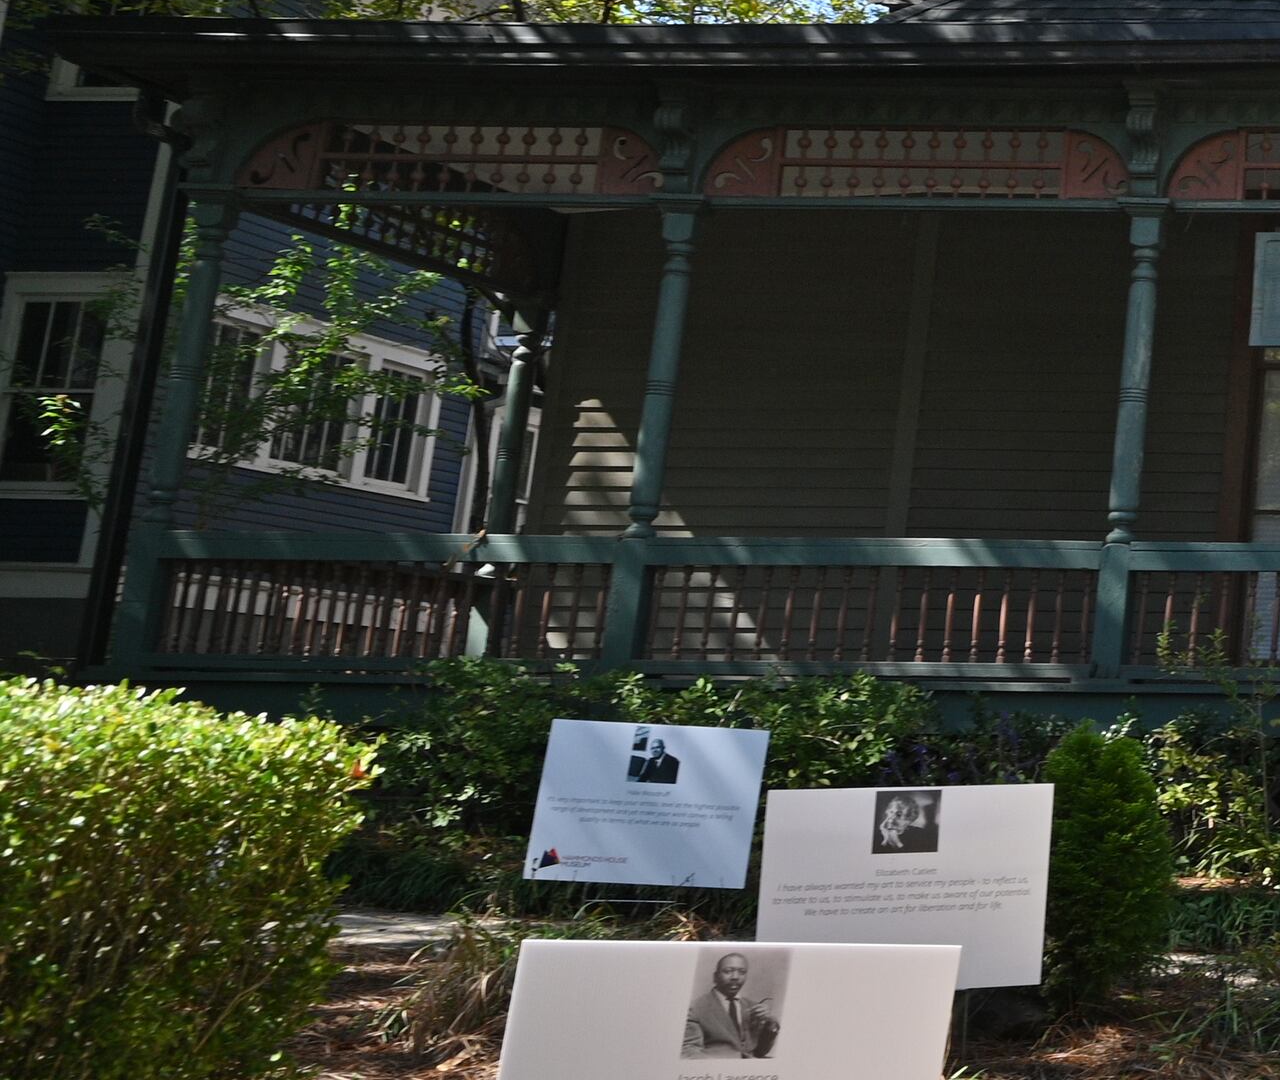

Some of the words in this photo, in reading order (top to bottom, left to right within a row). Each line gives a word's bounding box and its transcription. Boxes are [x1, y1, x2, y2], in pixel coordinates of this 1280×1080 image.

[875, 868, 910, 877] Elizabeth
[912, 867, 938, 876] Catlett
[783, 883, 802, 892] have
[804, 883, 832, 893] always
[834, 881, 866, 890] wanted
[867, 882, 880, 891] my
[881, 881, 893, 889] art
[905, 880, 932, 888] service
[933, 880, 947, 889] my
[949, 878, 976, 888] people
[982, 877, 992, 885] to
[993, 876, 1017, 886] reflect
[772, 897, 782, 905] to
[783, 896, 807, 905] relate
[808, 896, 818, 904] to
[832, 895, 842, 903] to
[843, 894, 882, 903] stimulate
[896, 893, 906, 901] to
[907, 892, 929, 900] make
[943, 891, 968, 899] aware
[969, 889, 979, 901] of
[979, 890, 993, 898] our
[804, 907, 818, 916] We
[819, 907, 839, 916] have
[840, 907, 850, 915] to
[851, 906, 876, 915] create
[878, 906, 890, 914] an
[891, 904, 904, 913] art
[903, 904, 918, 915] for
[920, 903, 957, 913] liberation
[958, 903, 974, 911] and
[974, 901, 989, 912] for
